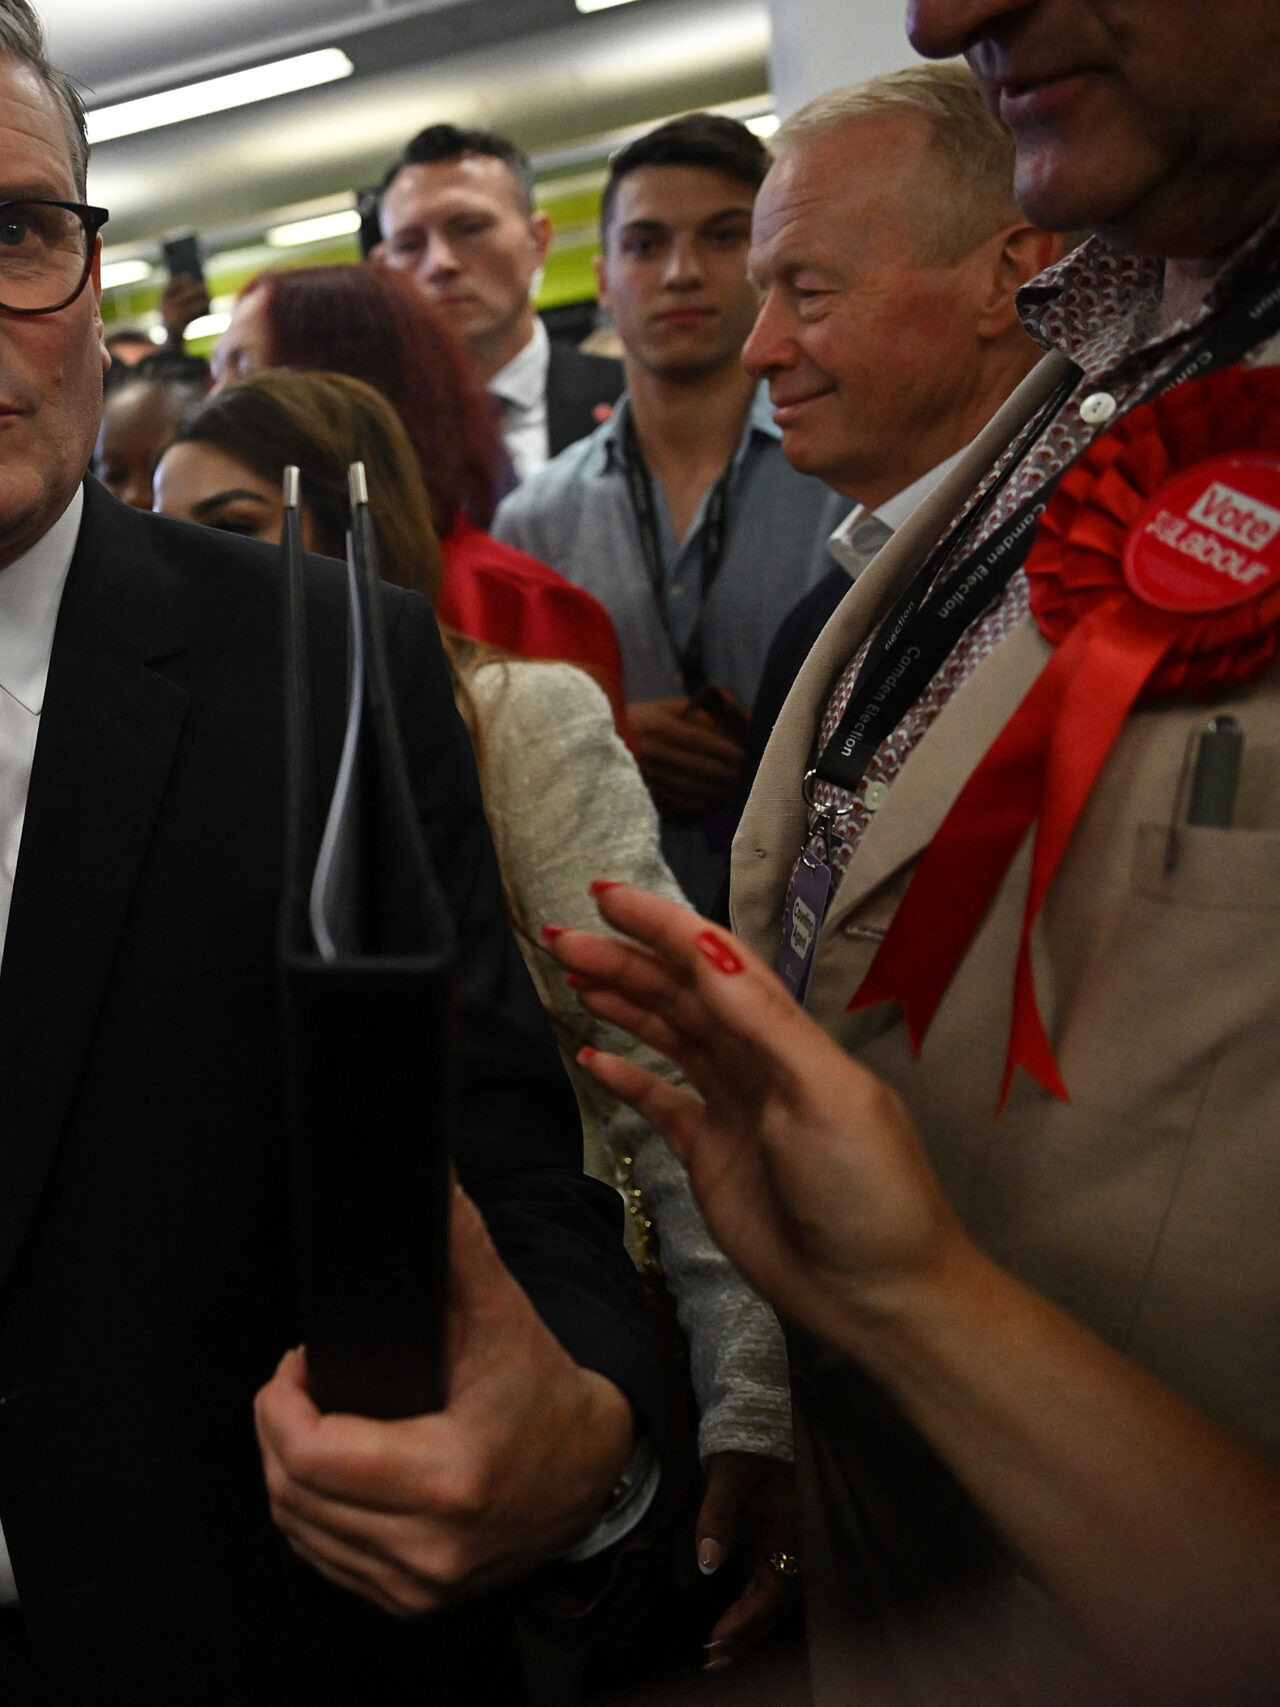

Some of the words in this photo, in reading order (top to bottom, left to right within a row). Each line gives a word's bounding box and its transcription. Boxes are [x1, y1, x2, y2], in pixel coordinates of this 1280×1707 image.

[985, 502, 1047, 566] Camden
[1203, 489, 1271, 542] Vote
[1160, 520, 1270, 586] Labour
[935, 564, 990, 620] Election
[872, 646, 922, 707] Camden
[840, 703, 881, 758] Election
